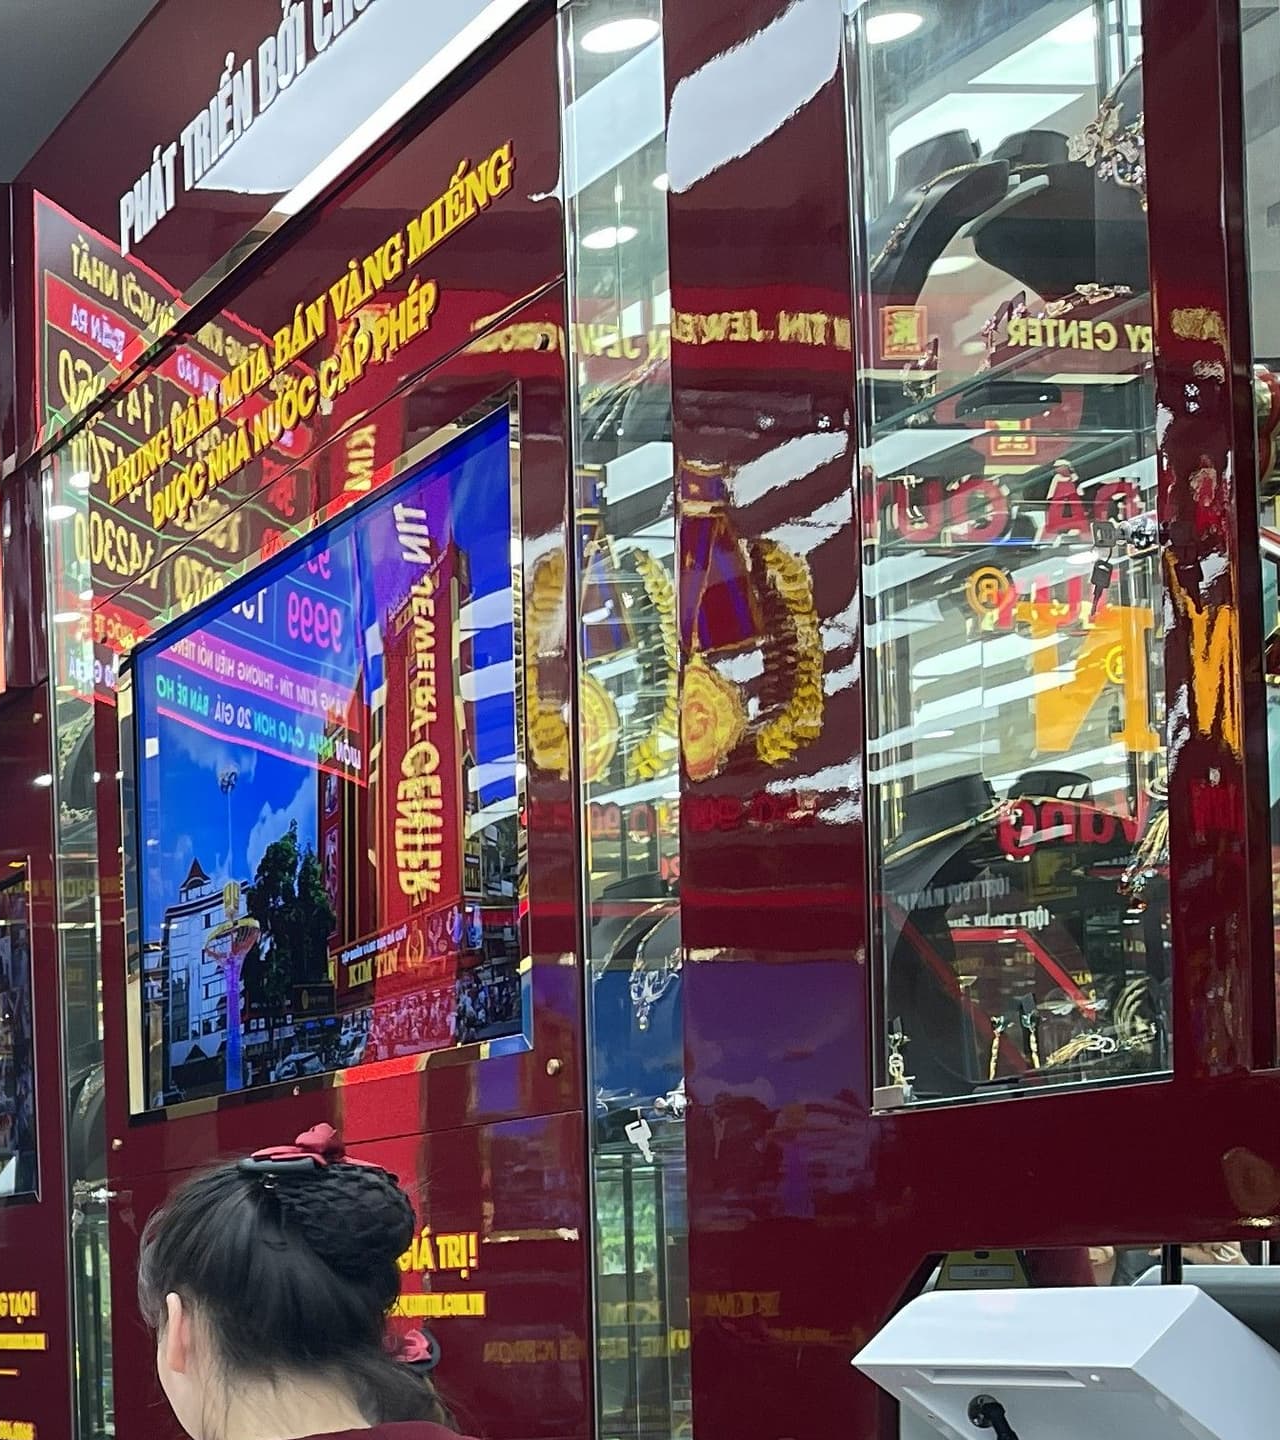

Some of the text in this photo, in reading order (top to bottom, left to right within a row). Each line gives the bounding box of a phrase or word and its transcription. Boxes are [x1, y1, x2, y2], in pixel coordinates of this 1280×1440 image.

[120, 141, 178, 257] PHÁT
[181, 51, 254, 191] TRIỂN
[105, 141, 514, 505] TRUNG TÂM MUA BÁN VÀNG MIẾNG
[151, 274, 439, 530] ĐƯỢC NHÀ NƯỚC CẤP PHÉP
[436, 1231, 479, 1280] TRỊ!
